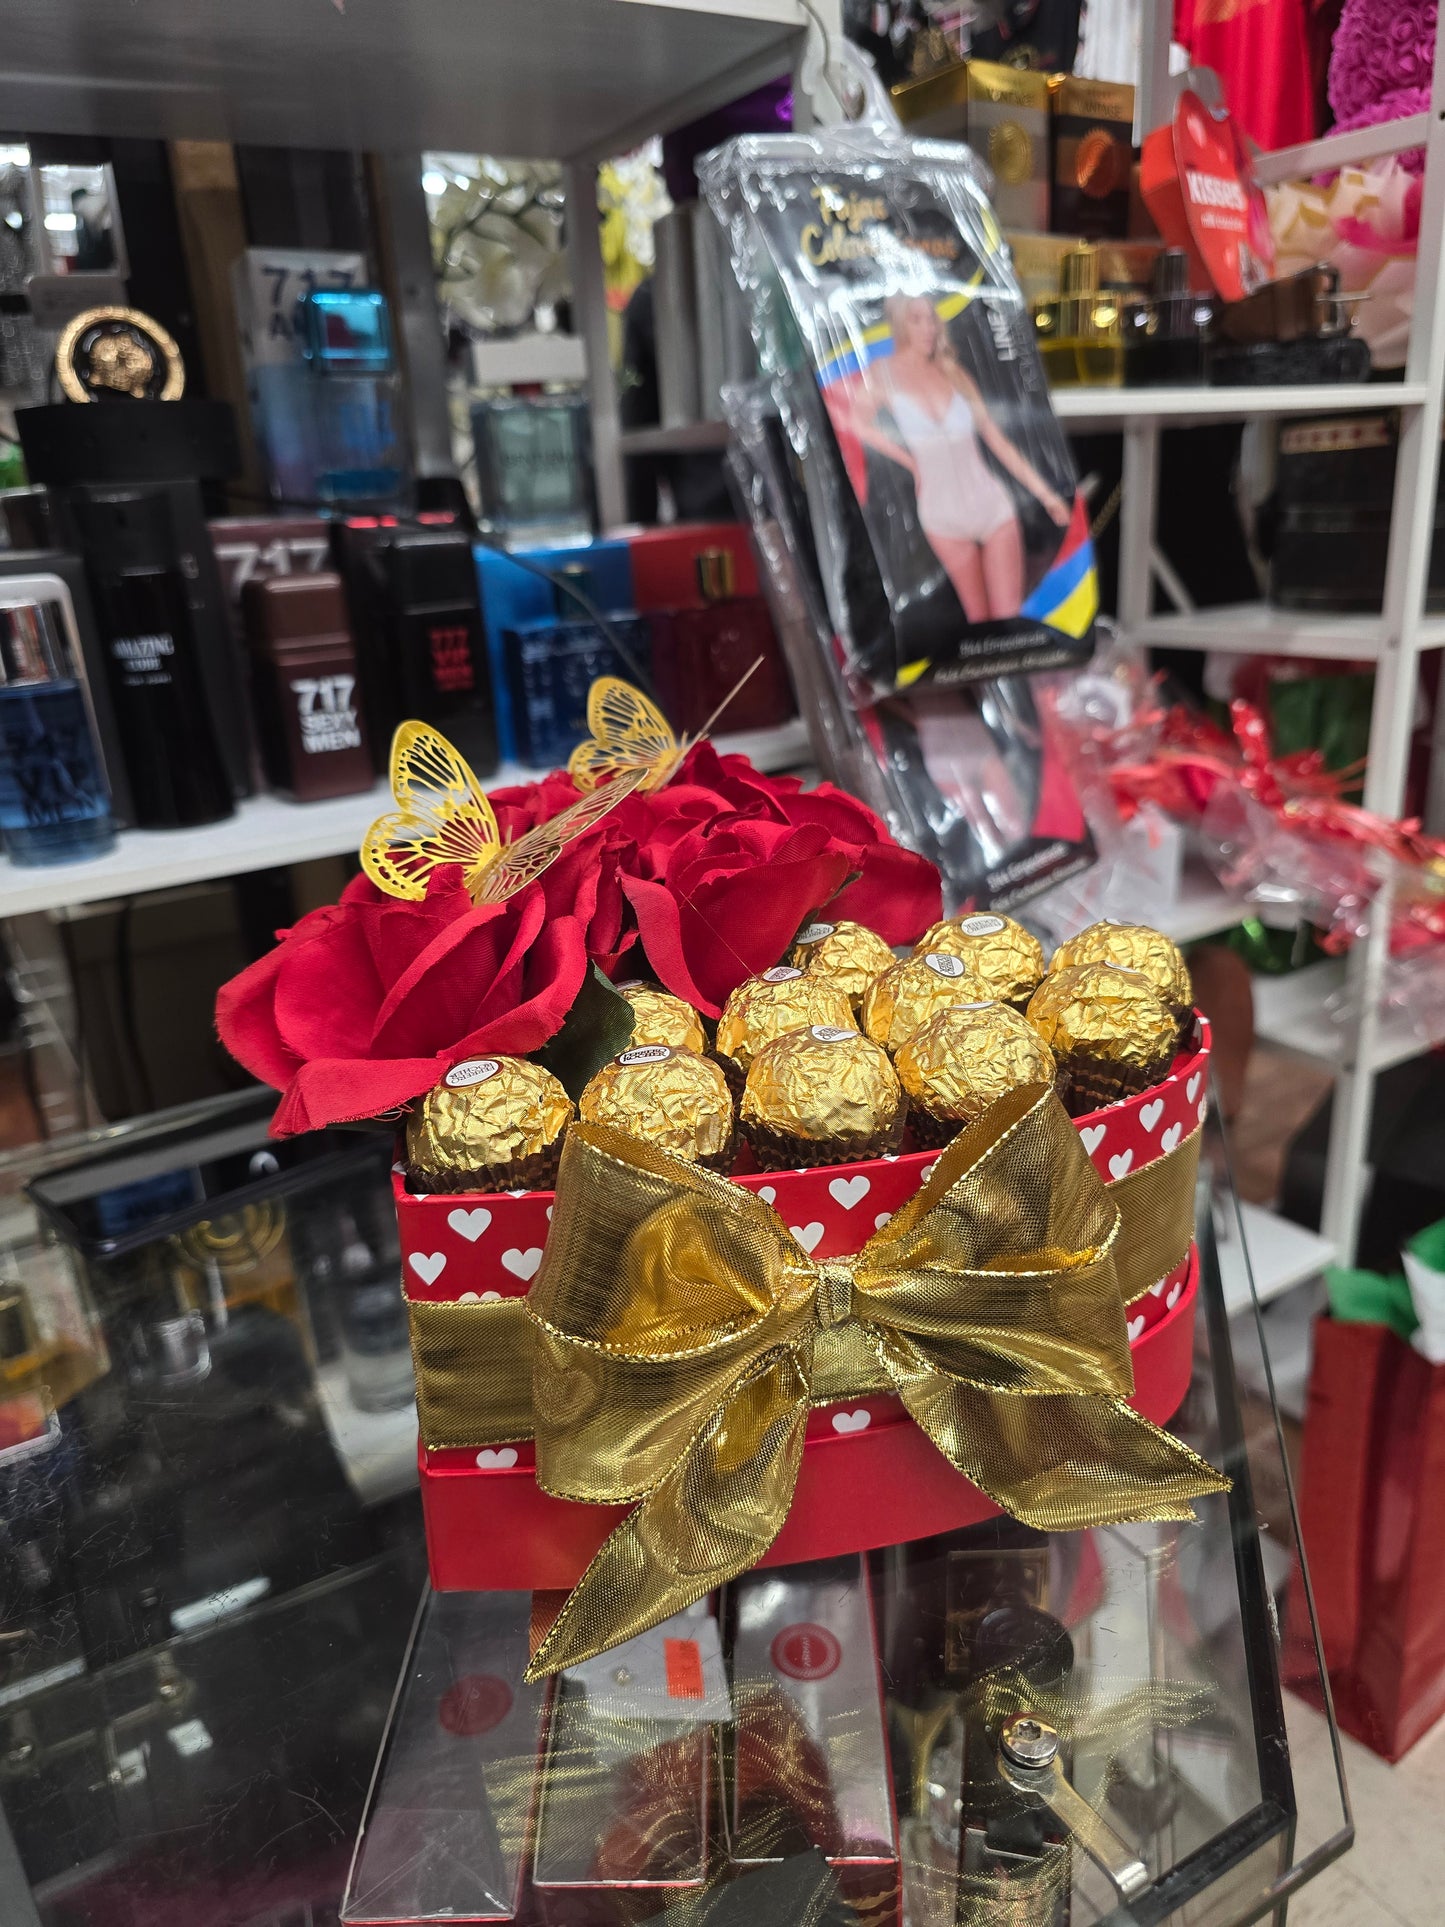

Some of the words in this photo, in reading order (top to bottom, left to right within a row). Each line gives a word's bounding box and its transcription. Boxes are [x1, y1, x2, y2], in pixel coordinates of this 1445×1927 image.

[213, 536, 330, 597] 717
[290, 673, 356, 716] 717
[302, 729, 362, 754] MEN
[449, 1062, 495, 1080] ROCHER
[451, 1066, 496, 1084] FERRERO
